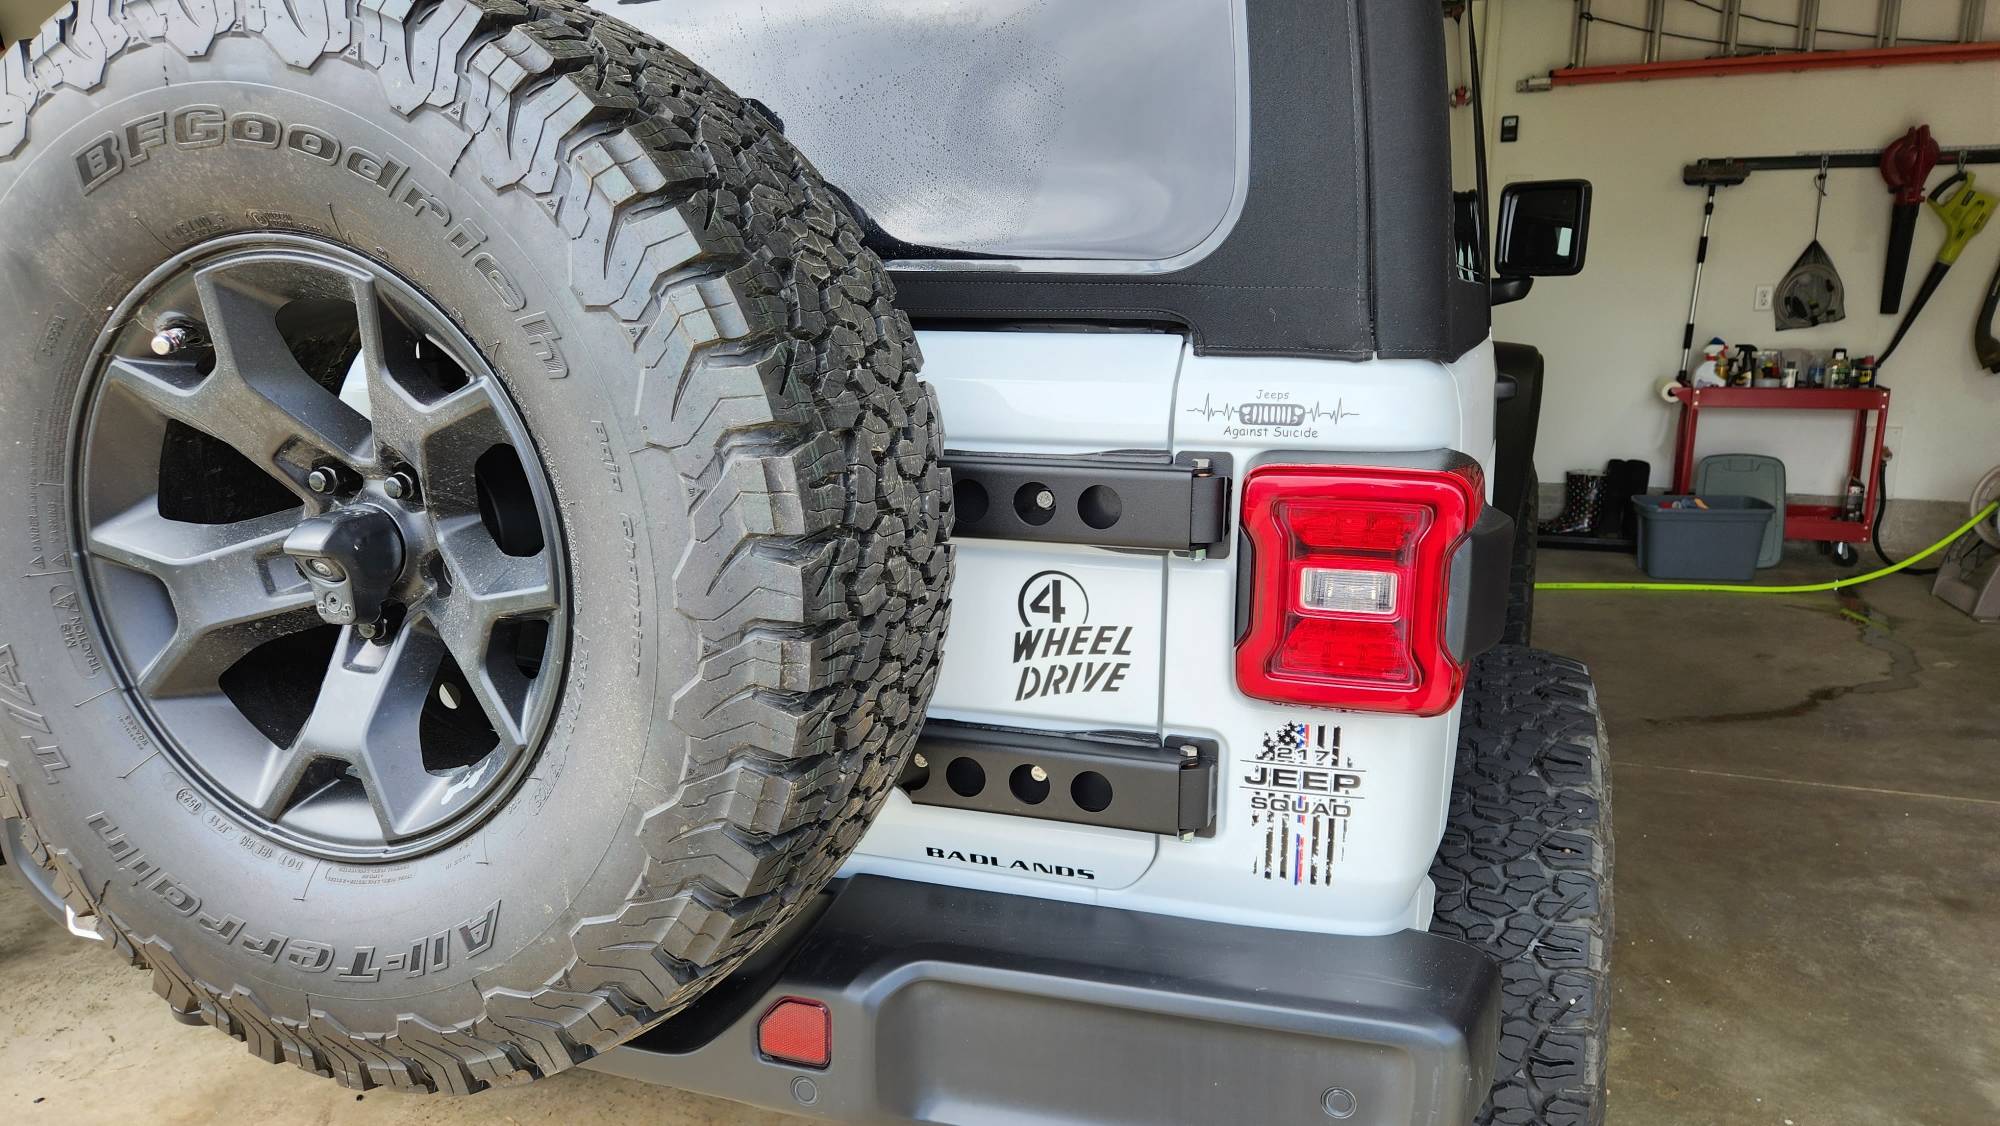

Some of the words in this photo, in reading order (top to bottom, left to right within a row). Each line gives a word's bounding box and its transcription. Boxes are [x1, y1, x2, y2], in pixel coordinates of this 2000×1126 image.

[71, 102, 571, 380] BFGoodrich
[1256, 389, 1290, 400] Jeeps
[1224, 426, 1269, 439] Against
[1273, 427, 1319, 438] Suicide
[1029, 579, 1066, 624] 4
[70, 616, 102, 675] TRACTION
[1012, 625, 1134, 664] WHEEL
[1015, 661, 1132, 702] DRIVE
[1277, 747, 1330, 761] 217
[1244, 766, 1361, 792] JEEP
[1250, 796, 1352, 818] SQUAD
[925, 846, 1095, 880] BADLANDS
[85, 810, 501, 984] All-Terrain
